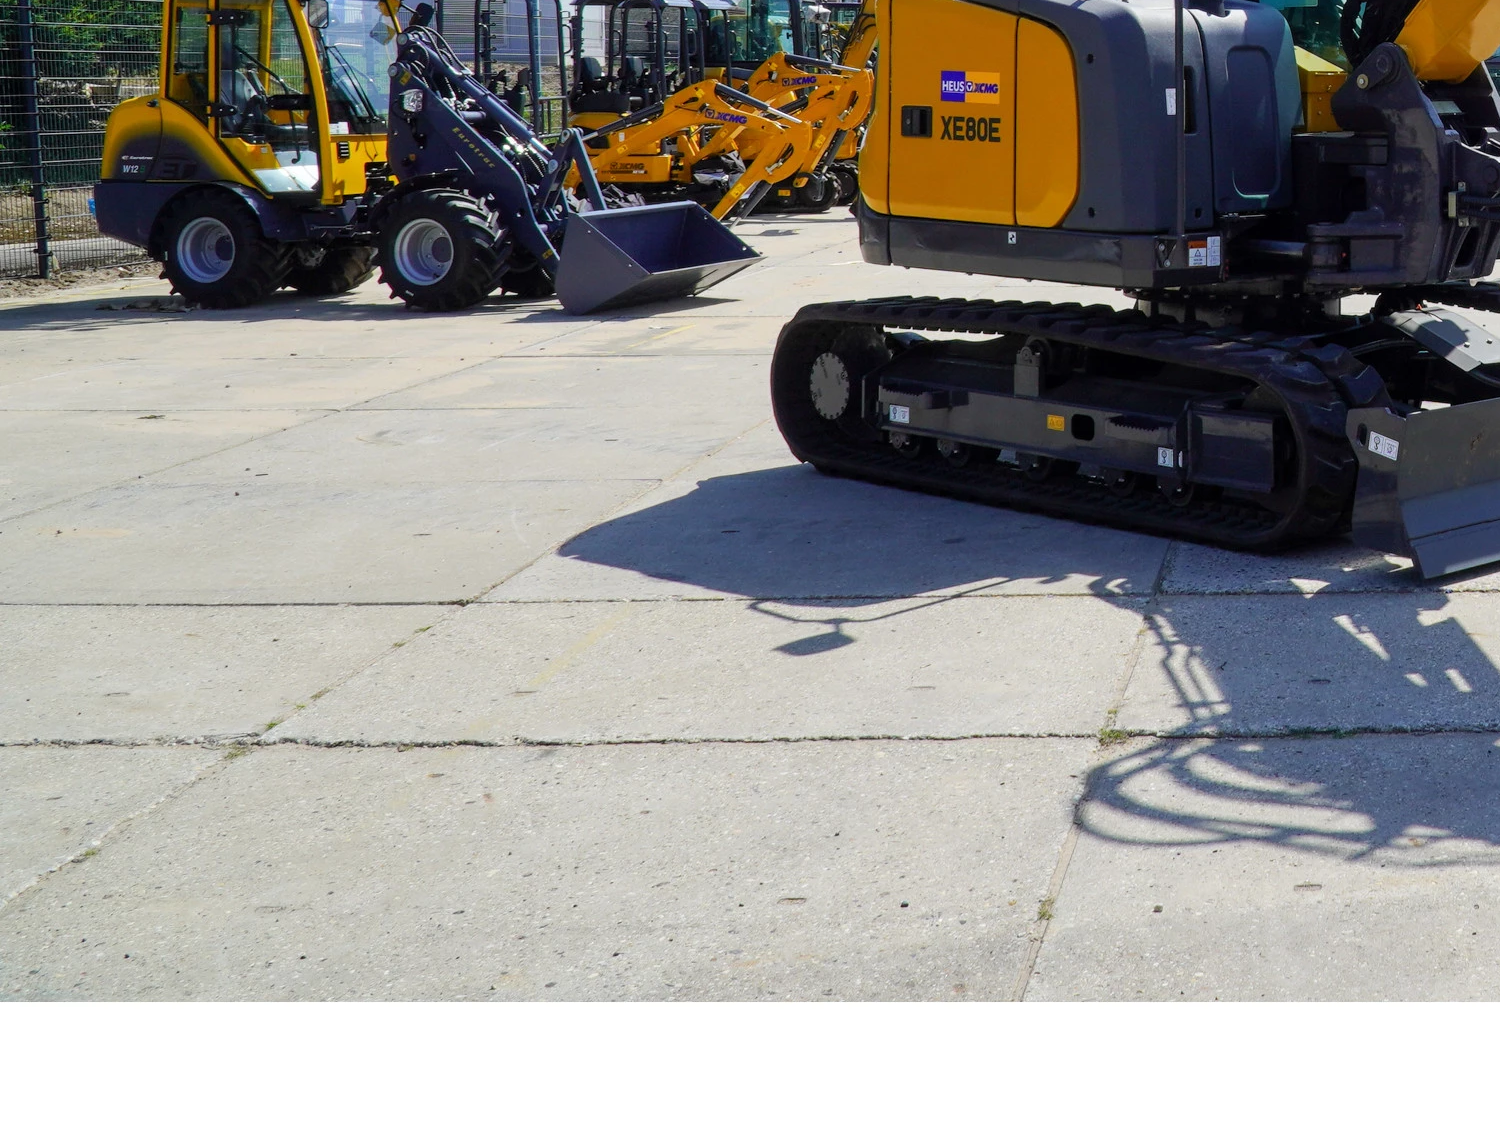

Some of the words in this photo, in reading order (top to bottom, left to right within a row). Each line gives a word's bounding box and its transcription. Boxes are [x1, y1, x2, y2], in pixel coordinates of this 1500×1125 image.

[790, 75, 817, 86] XCMG
[942, 80, 965, 92] HEUS
[971, 82, 999, 94] XCMG
[714, 111, 748, 125] XCMG
[940, 115, 1001, 143] XE80E
[452, 126, 496, 168] Eurotrac
